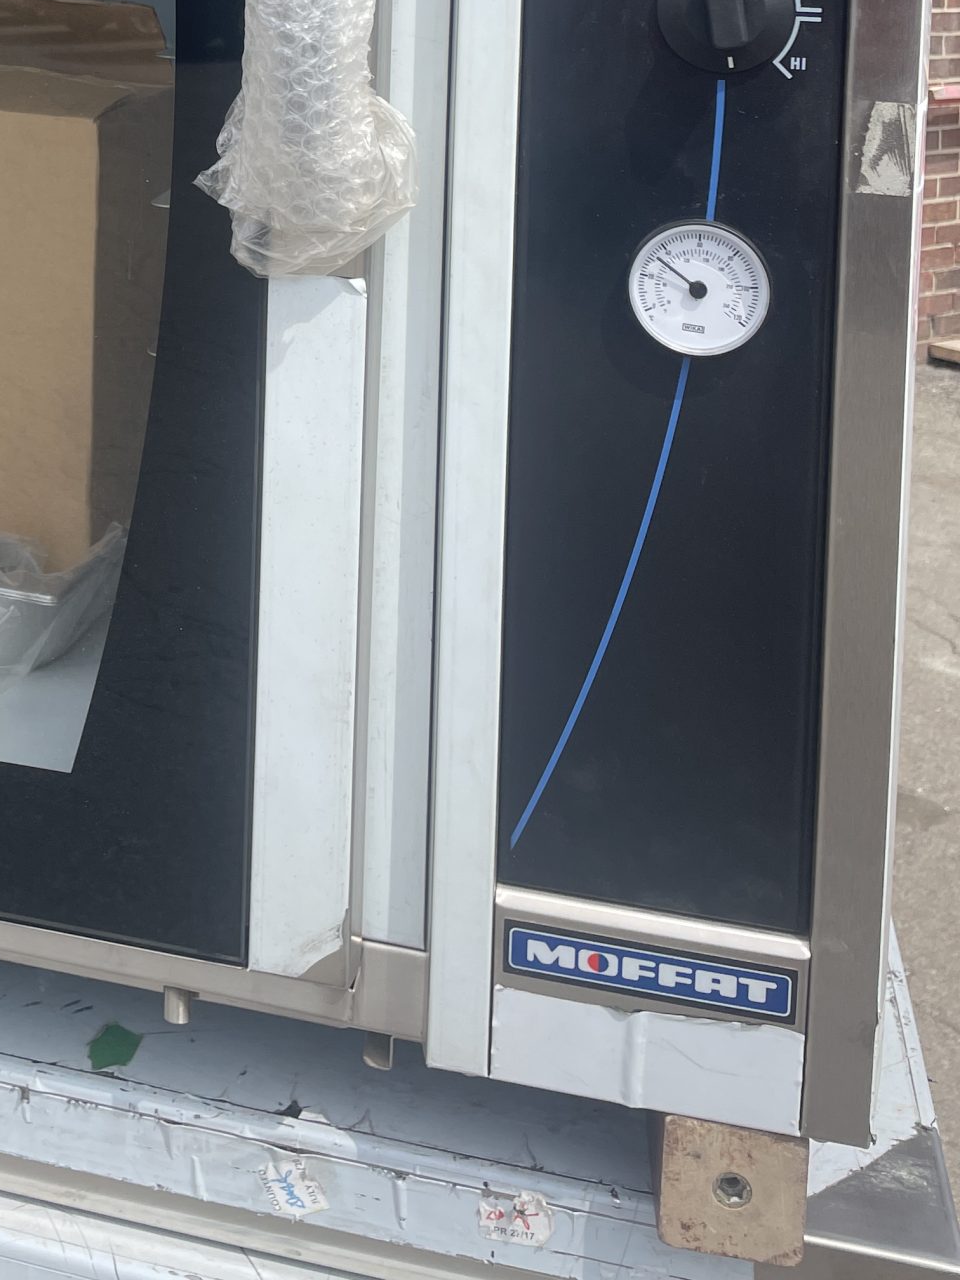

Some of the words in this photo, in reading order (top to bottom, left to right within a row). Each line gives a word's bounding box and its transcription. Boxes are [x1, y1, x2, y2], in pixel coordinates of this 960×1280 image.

[790, 57, 807, 71] HI
[526, 939, 778, 1004] MOFFAT
[303, 1183, 321, 1206] JULY
